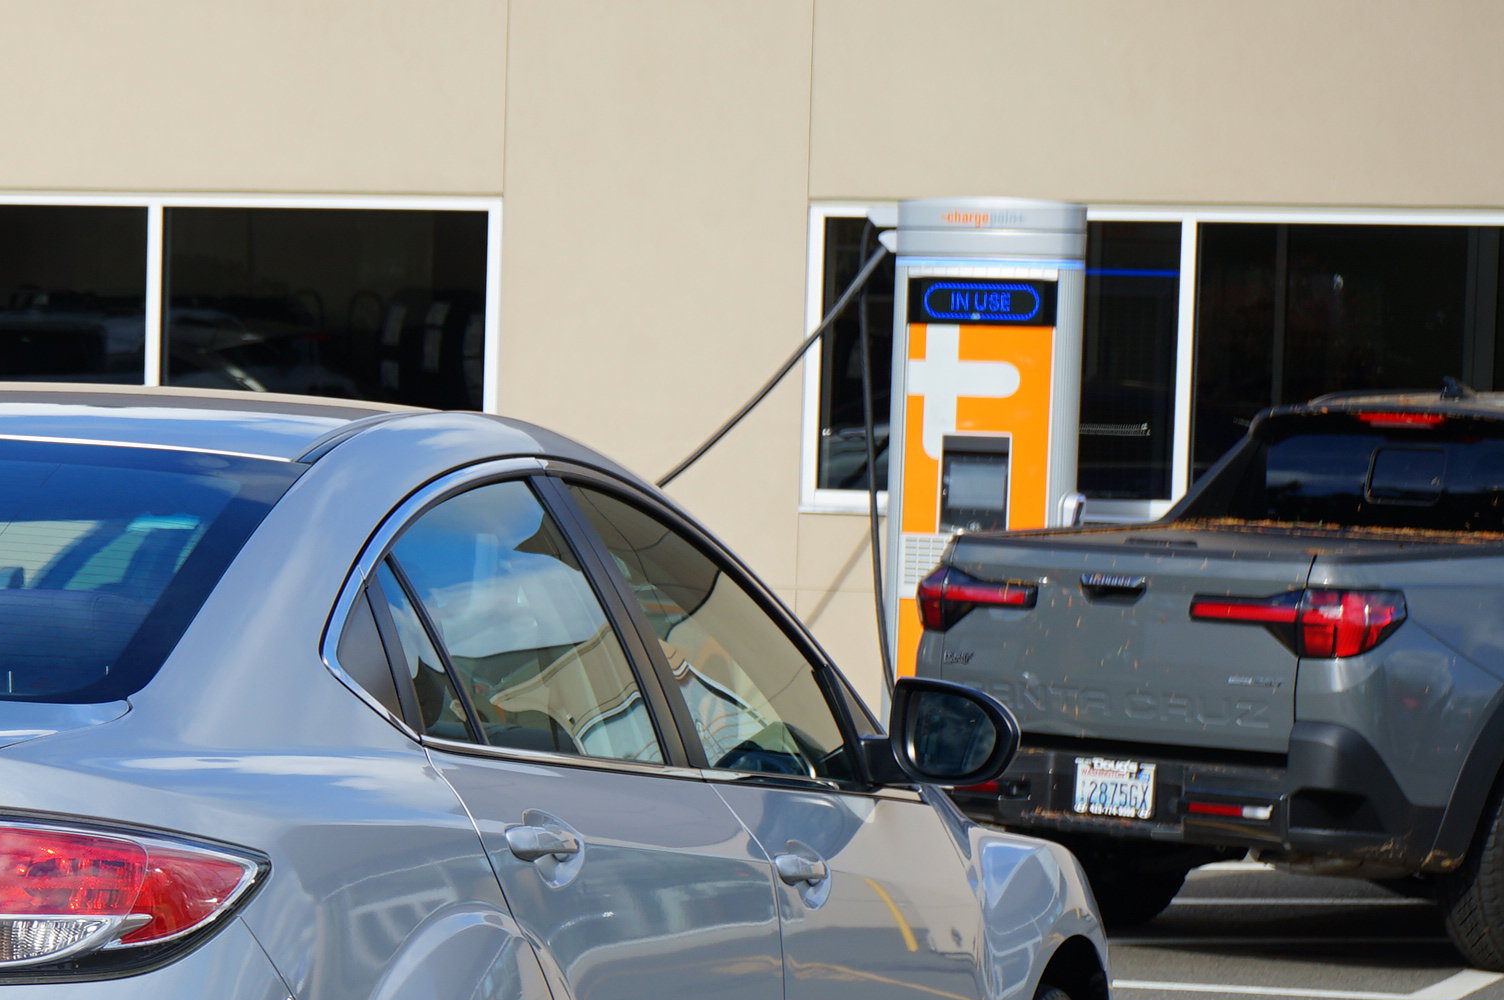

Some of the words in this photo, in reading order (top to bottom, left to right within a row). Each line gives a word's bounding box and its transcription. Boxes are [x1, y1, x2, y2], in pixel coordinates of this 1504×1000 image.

[950, 291, 970, 312] IN
[974, 291, 1012, 313] USE
[1124, 687, 1271, 729] CRUZ
